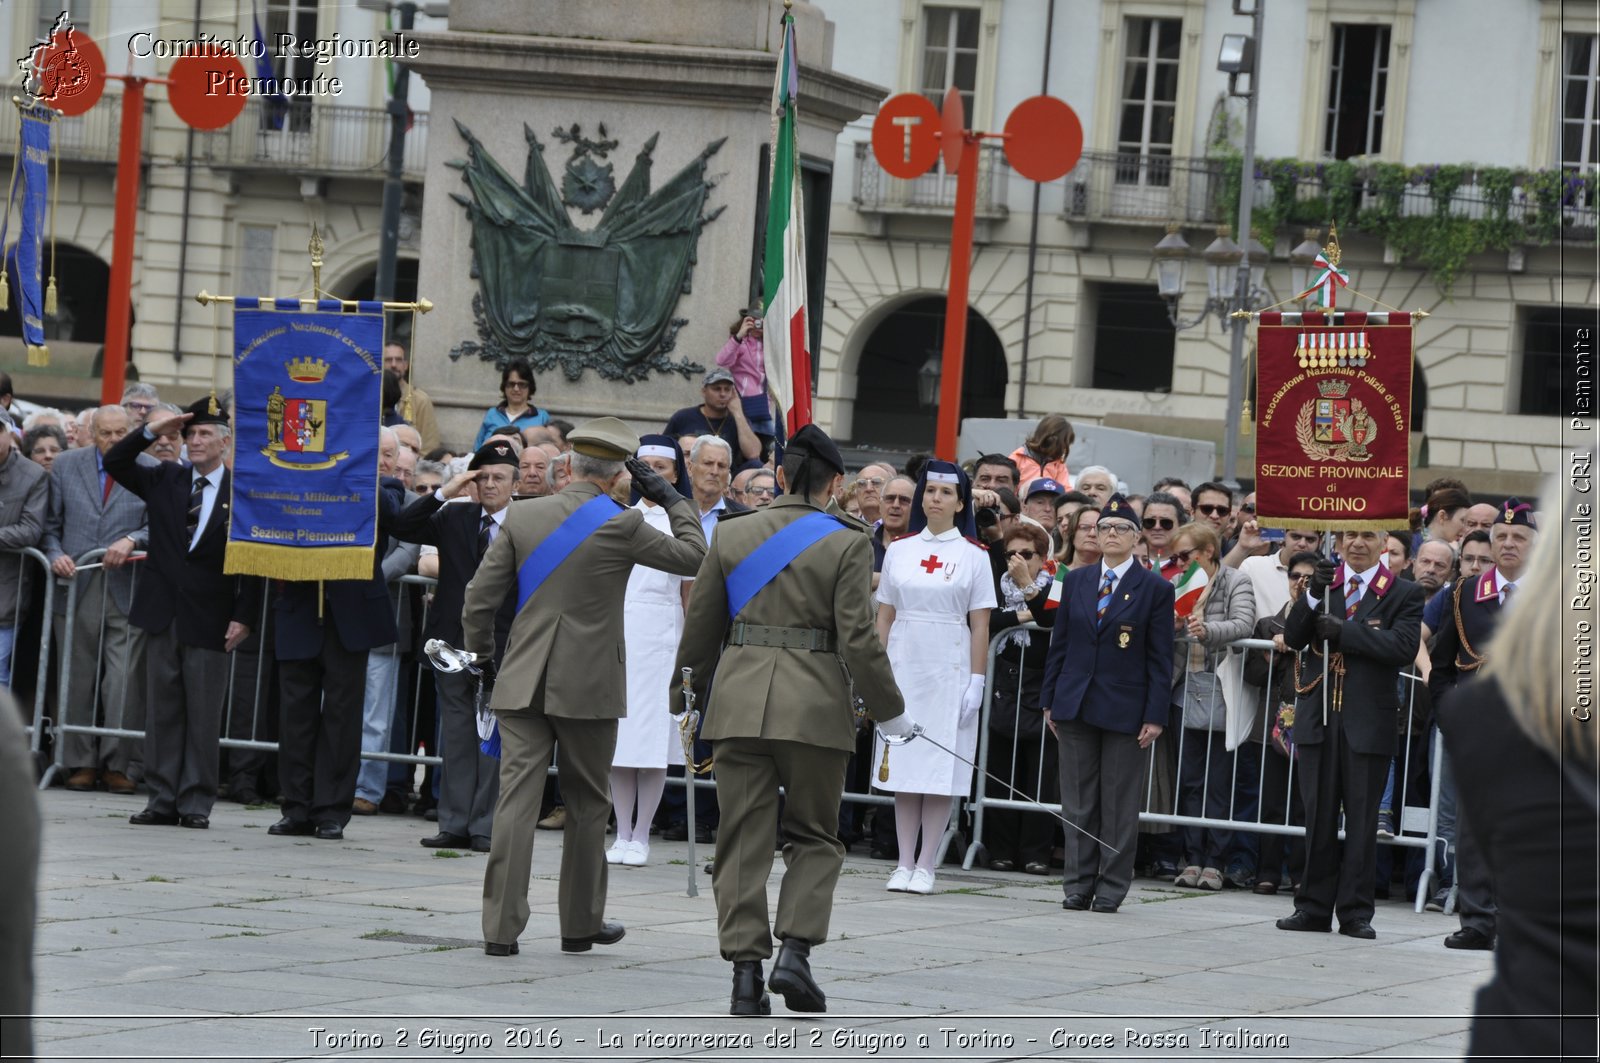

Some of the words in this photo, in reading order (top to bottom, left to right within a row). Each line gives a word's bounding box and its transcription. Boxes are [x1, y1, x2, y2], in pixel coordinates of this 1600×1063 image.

[892, 116, 922, 163] T
[290, 321, 342, 340] Nazionale
[1262, 373, 1305, 429] Associazione
[1305, 366, 1356, 378] Nazionale
[1356, 369, 1387, 395] Polizia
[1384, 393, 1396, 404] di
[1390, 402, 1404, 432] Stato
[1261, 463, 1315, 478] SEZIONE
[1319, 466, 1404, 478] PROVINCIALE
[1326, 482, 1337, 493] di
[303, 491, 347, 503] Militare
[349, 492, 361, 503] di
[1297, 496, 1367, 512] TORINO
[250, 525, 295, 541] Sezione
[297, 528, 356, 543] Piemonte
